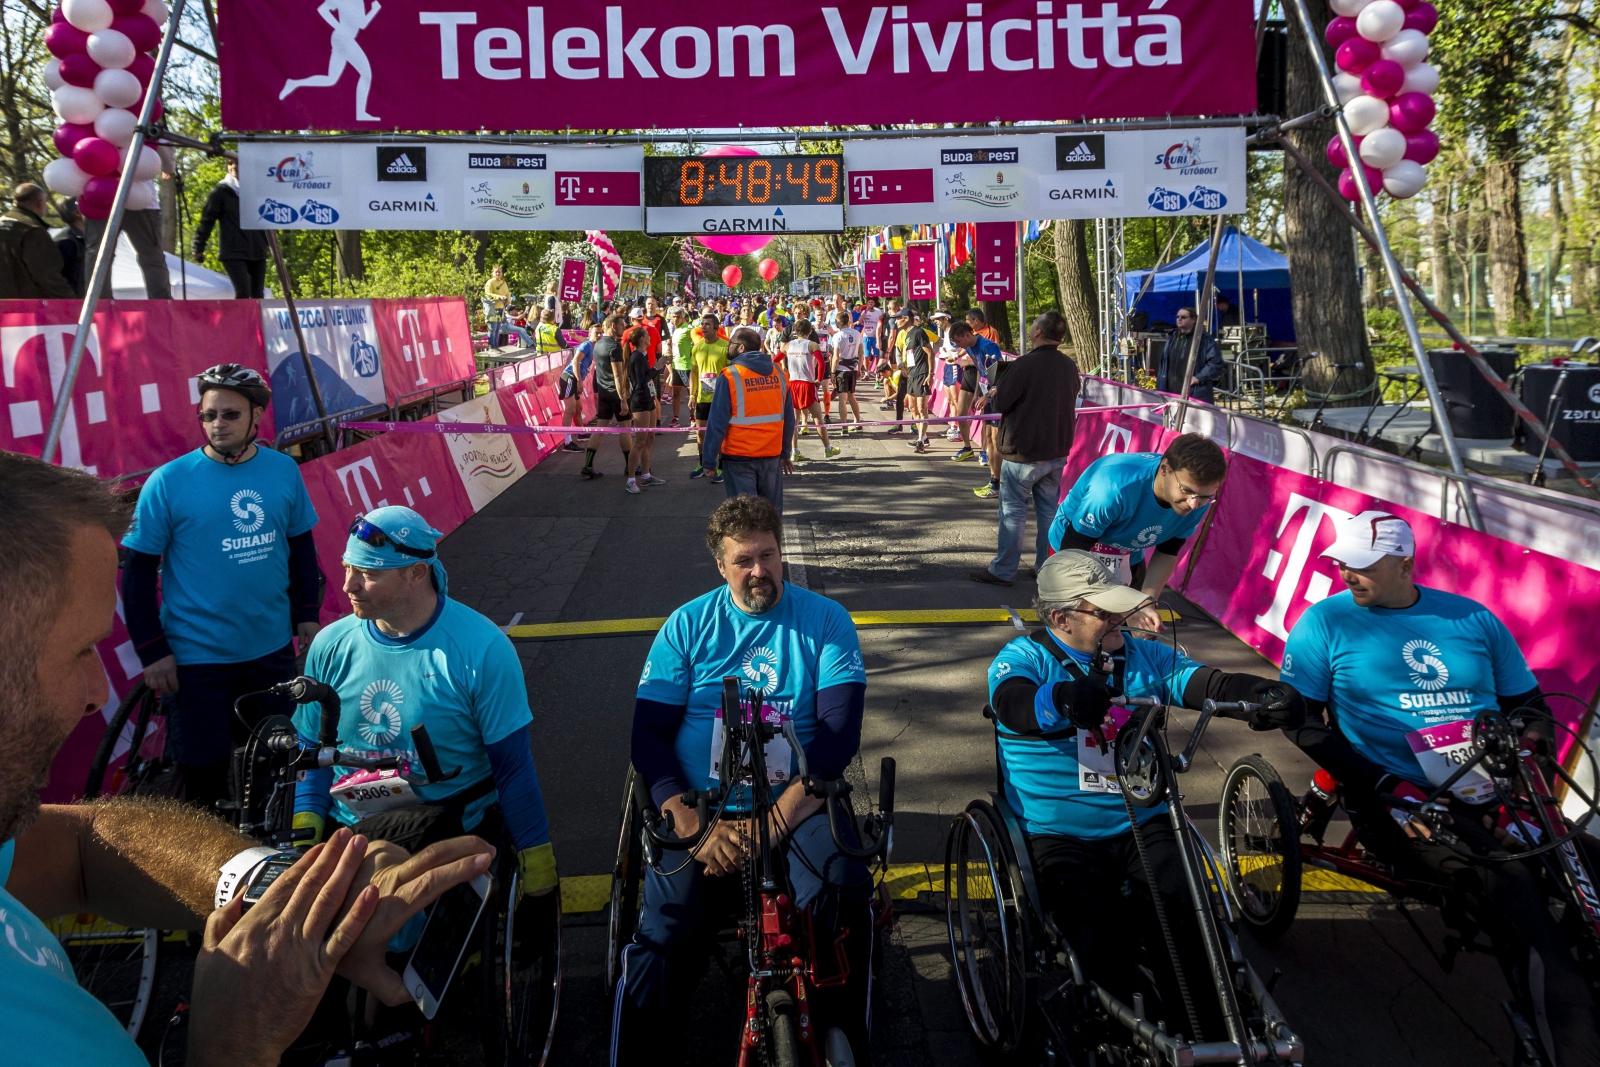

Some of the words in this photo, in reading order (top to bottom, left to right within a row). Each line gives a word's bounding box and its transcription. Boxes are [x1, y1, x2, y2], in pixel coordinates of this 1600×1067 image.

[419, 6, 796, 80] Telekom
[821, 0, 1183, 76] Vivicittá
[1065, 153, 1096, 163] adidas
[1154, 154, 1188, 165] SPURI
[266, 166, 301, 178] SPURI
[386, 164, 418, 174] adidas
[1179, 166, 1219, 176] FUTÓBOLT
[292, 181, 332, 190] FUTÓBOLT
[680, 159, 839, 205] 8:48:49
[951, 187, 983, 198] SPORTOLÓ
[984, 190, 1020, 201] NEMZETÉRT
[1049, 187, 1116, 200] GARMIN
[368, 200, 437, 212] GARMIN
[477, 197, 509, 208] SPORTOLÓ
[511, 202, 546, 212] NEMZETÉRT
[1163, 194, 1181, 211] BSI
[1203, 193, 1221, 209] BSI
[274, 207, 292, 223] BSI
[315, 208, 333, 223] BSI
[702, 218, 787, 232] GARMIN
[277, 309, 328, 330] MZOGJ
[221, 529, 276, 552] SUHANJ!
[1398, 689, 1473, 710] SUHANJ!
